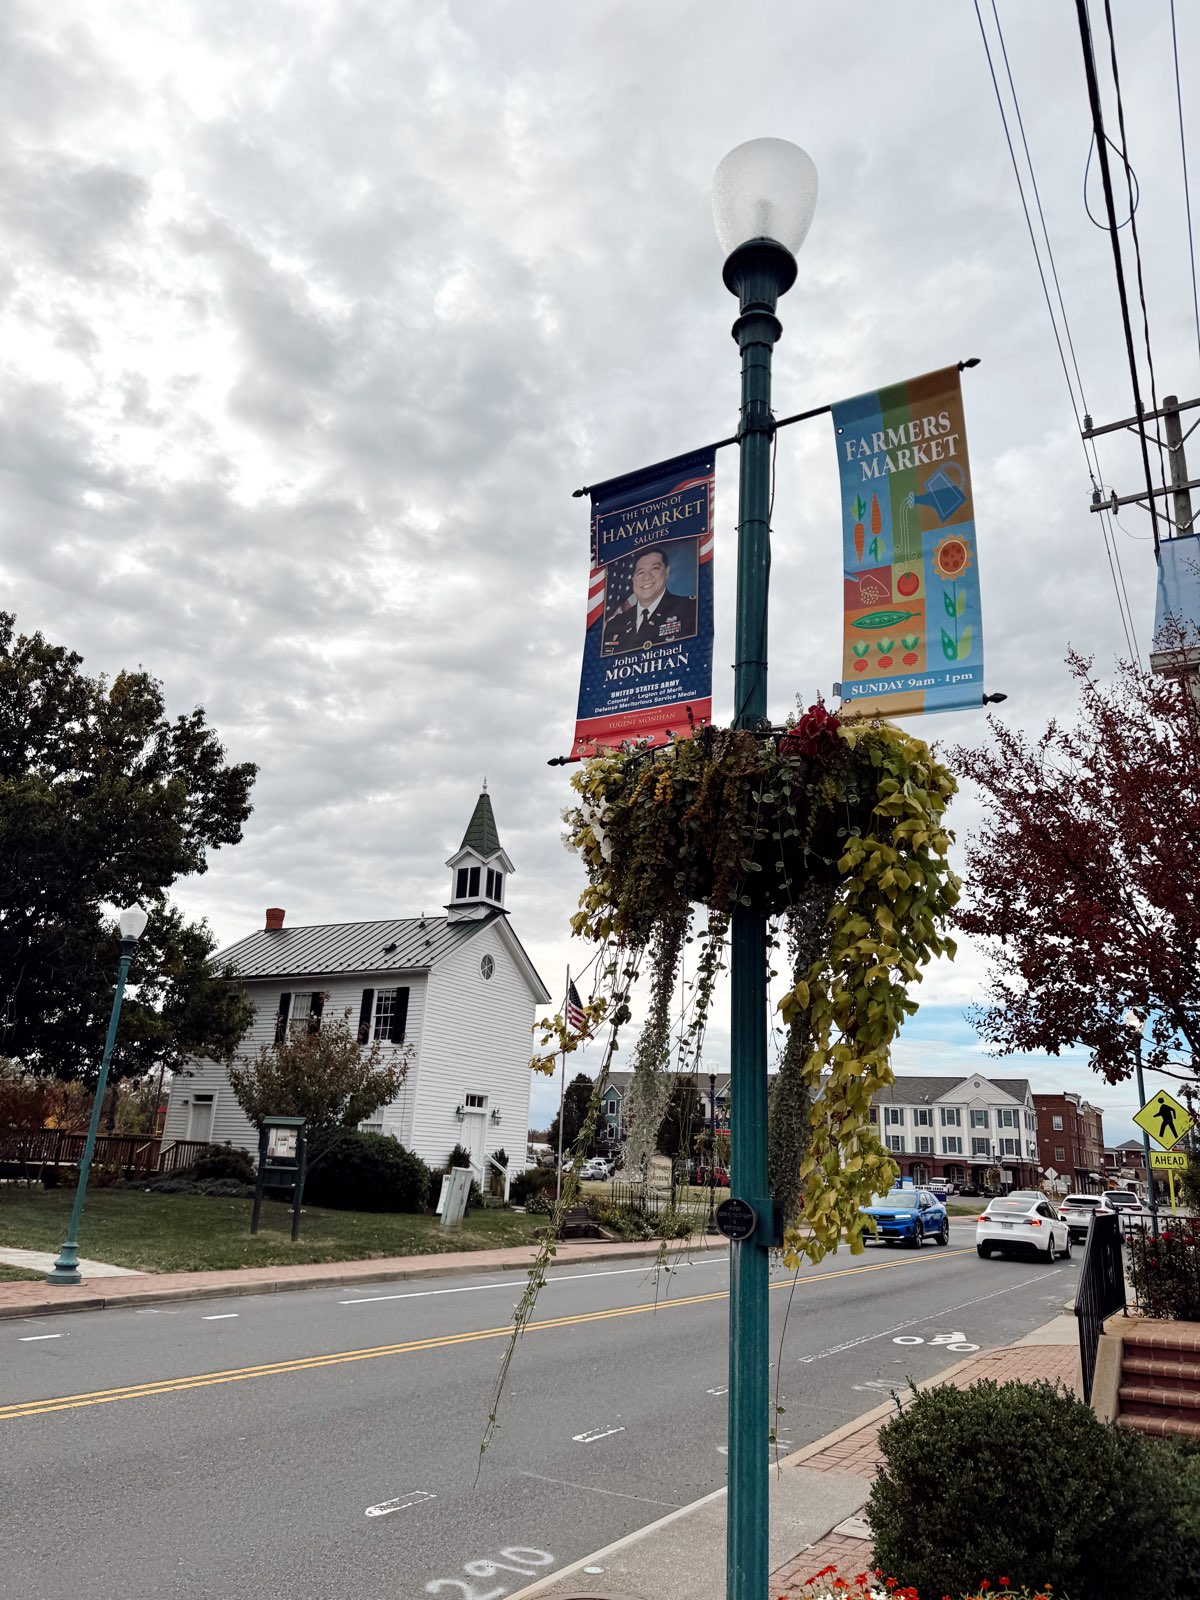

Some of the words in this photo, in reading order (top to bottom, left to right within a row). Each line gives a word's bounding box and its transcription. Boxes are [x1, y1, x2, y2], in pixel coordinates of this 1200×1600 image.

[844, 411, 951, 461] FARMERS
[860, 434, 960, 482] MARKET
[621, 507, 639, 522] THE
[642, 499, 669, 515] TOWN
[670, 494, 684, 506] OF
[602, 499, 704, 544] HAYMARKET
[633, 528, 670, 546] SALUTES
[604, 652, 689, 682] MONIHAN
[612, 654, 638, 667] John
[641, 644, 682, 660] Michael
[607, 697, 629, 705] Colonel
[637, 691, 658, 700] Legion
[667, 686, 683, 694] Merit
[610, 688, 634, 698] UNITED
[635, 683, 659, 693] STATES
[659, 679, 680, 690] ARMY
[851, 679, 905, 695] SUNDAY
[908, 677, 936, 687] 9am
[594, 704, 618, 713] Defense
[619, 698, 653, 709] Meritorious
[654, 694, 676, 703] Service
[677, 690, 697, 698] Medal
[608, 719, 637, 729] EUGENE
[637, 712, 676, 724] MONIHAN
[1154, 1156, 1185, 1166] AHEAD
